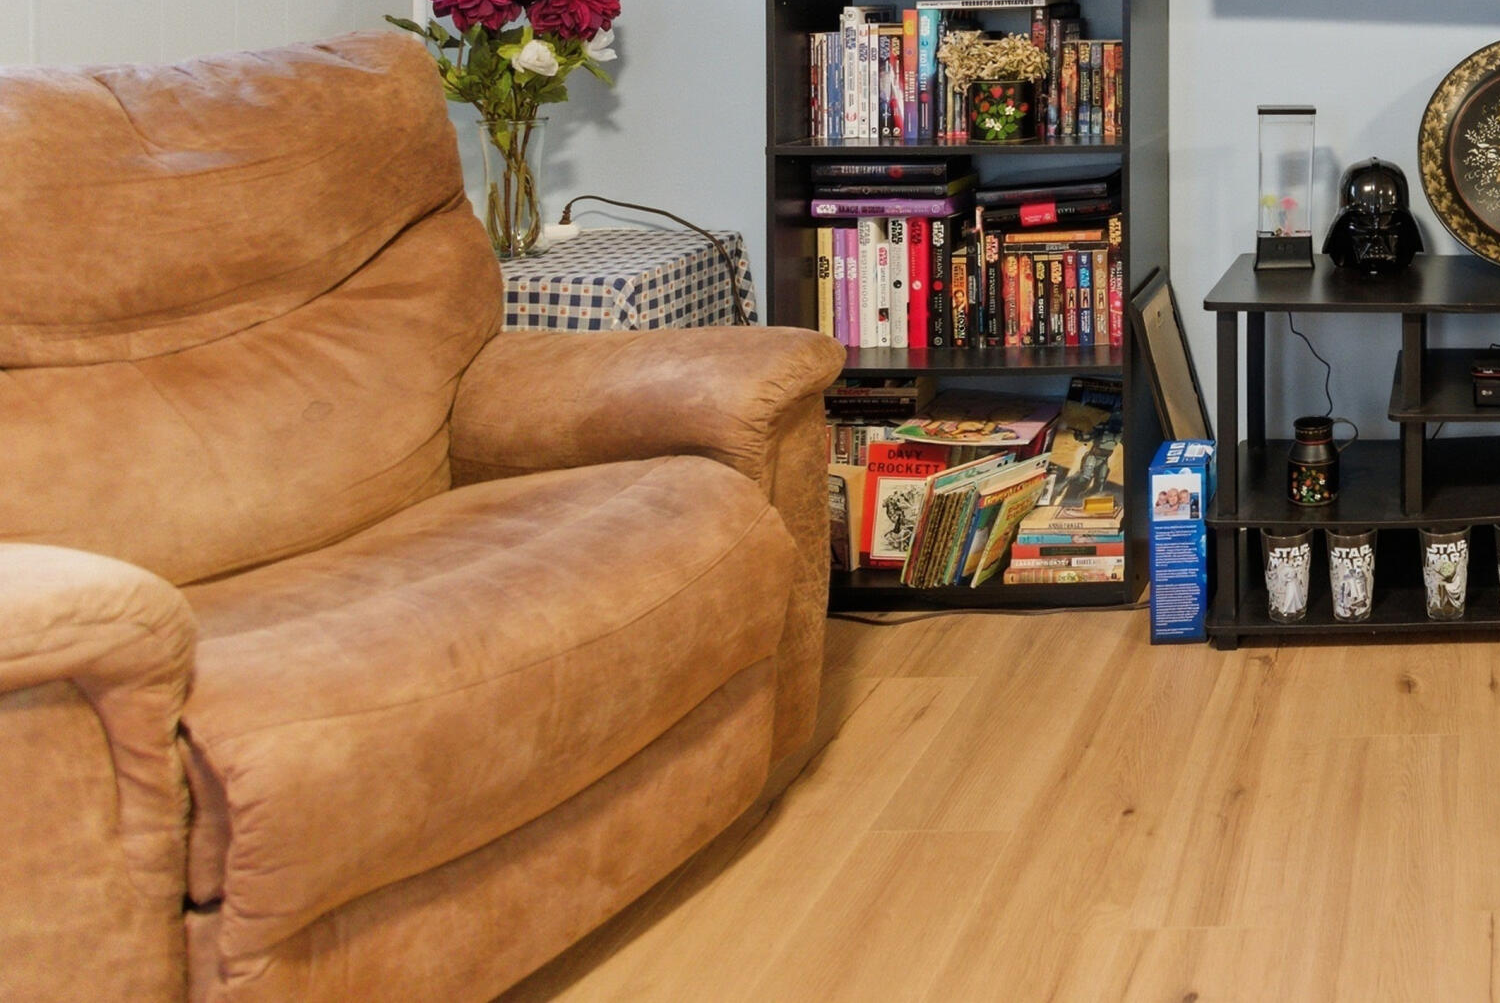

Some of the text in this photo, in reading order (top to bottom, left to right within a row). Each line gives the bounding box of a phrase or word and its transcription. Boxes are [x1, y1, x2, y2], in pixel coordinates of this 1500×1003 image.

[861, 249, 869, 309] BROTHERHOOD
[888, 449, 923, 461] DAVY
[868, 462, 940, 475] CROCKETT
[1269, 543, 1310, 558] STAR
[1330, 544, 1373, 558] STAR
[1426, 539, 1468, 554] STAR
